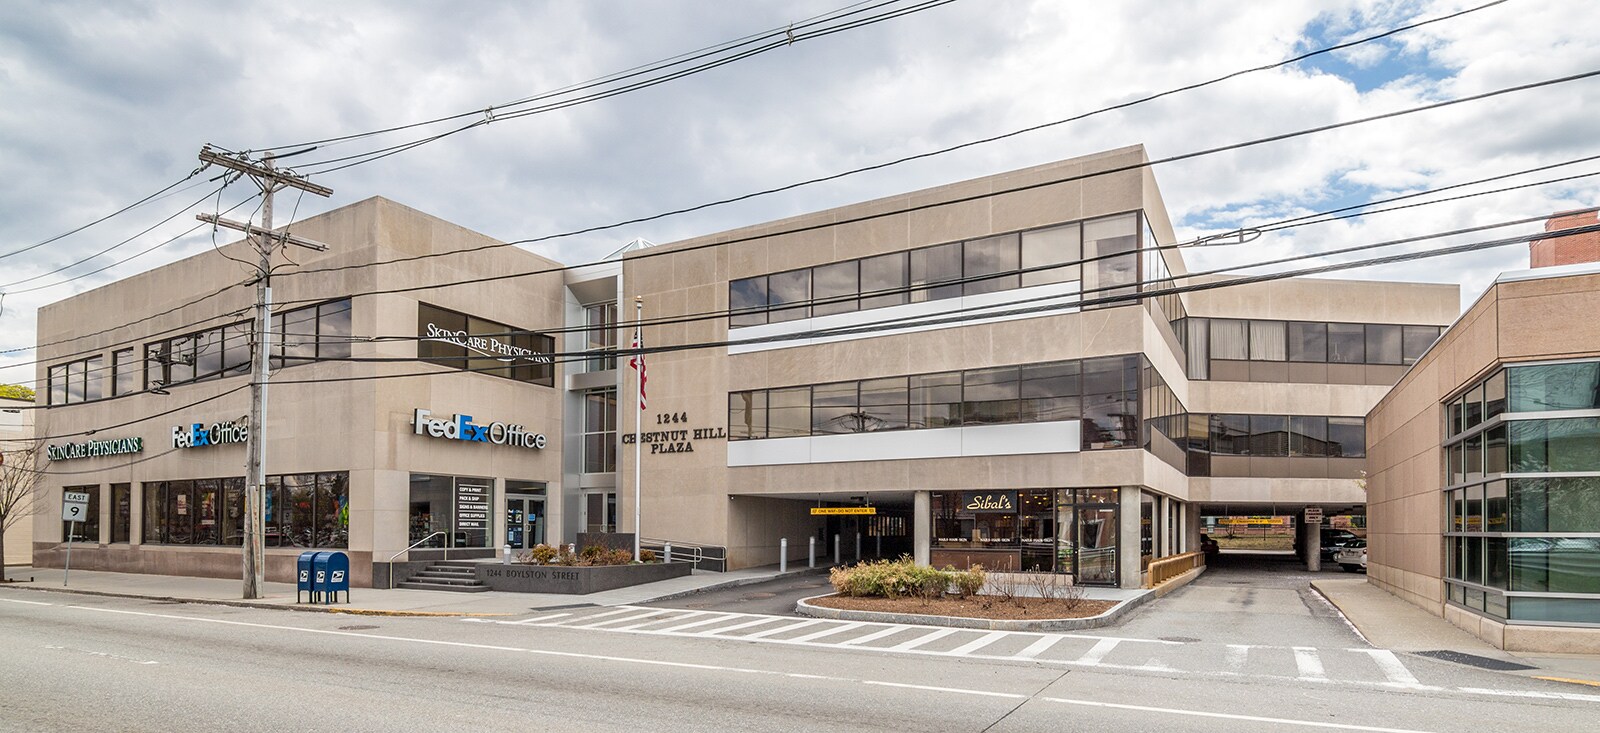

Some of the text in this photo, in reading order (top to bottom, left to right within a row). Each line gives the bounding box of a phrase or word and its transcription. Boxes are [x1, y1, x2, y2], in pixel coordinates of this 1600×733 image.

[657, 412, 688, 424] 1244
[414, 408, 547, 449] FedEx Office
[693, 428, 726, 440] HILL
[171, 421, 248, 449] FedEx Office
[651, 442, 694, 454] PLAZA
[966, 494, 1012, 510] Sibal's
[70, 506, 80, 517] 9
[486, 569, 580, 580] 1244 BOYLSTON STREET
